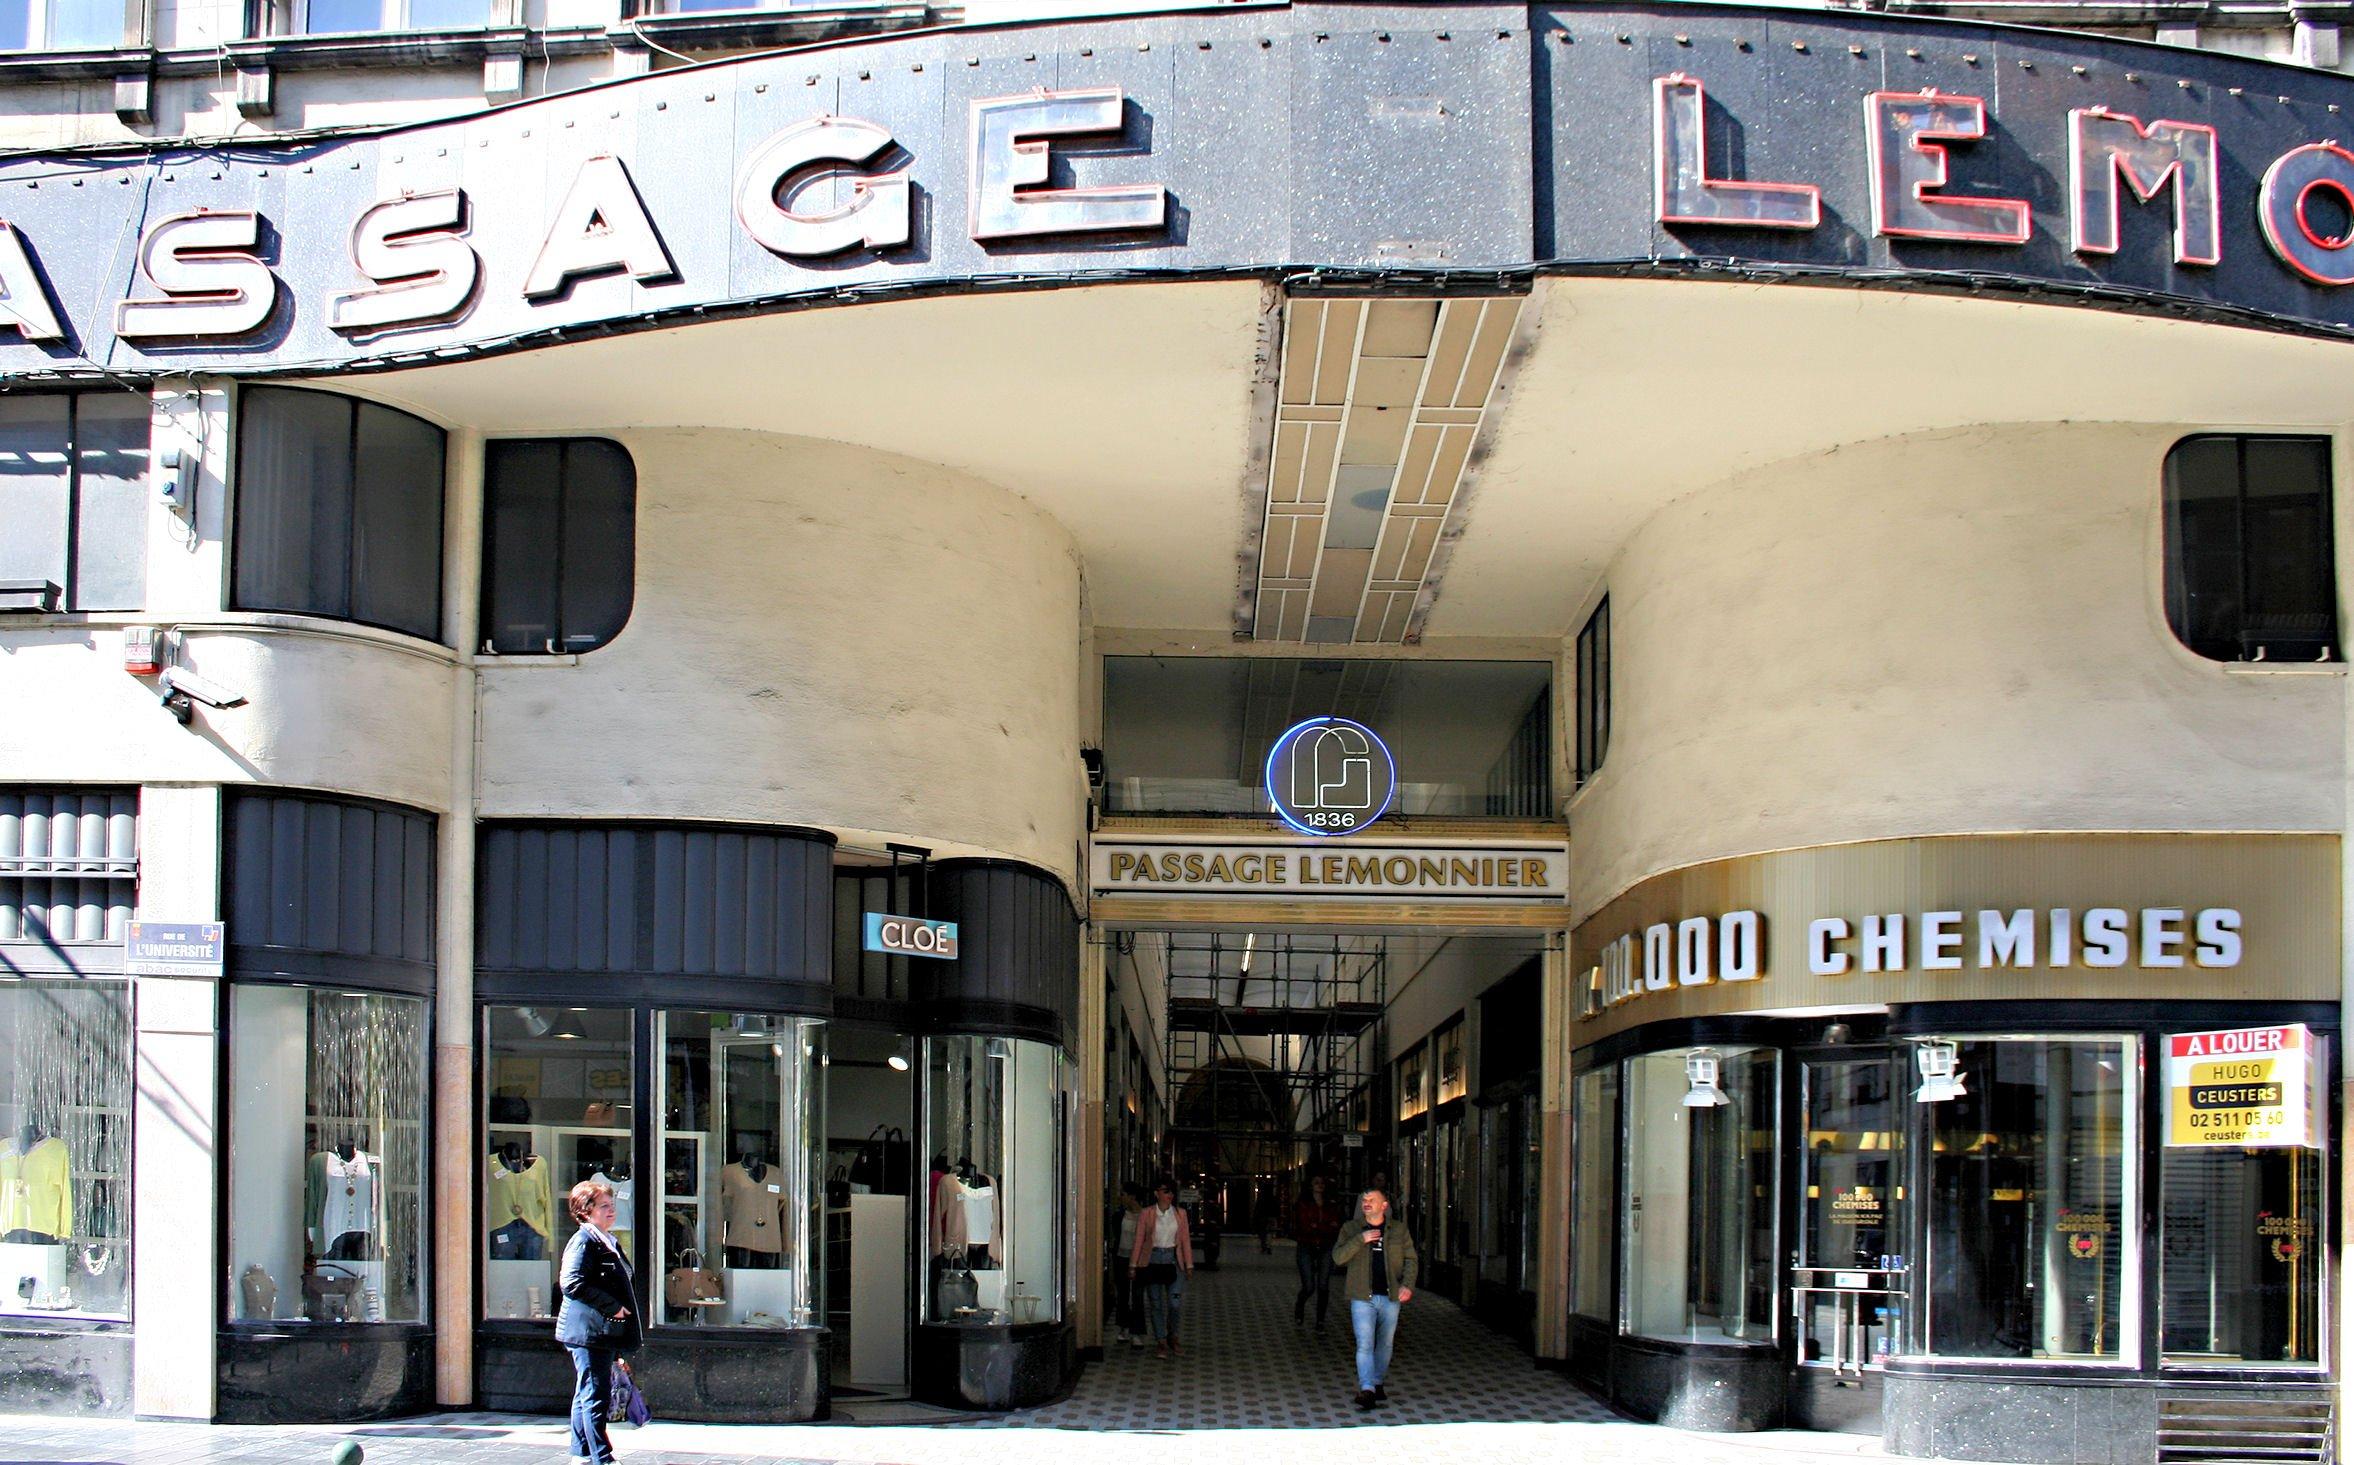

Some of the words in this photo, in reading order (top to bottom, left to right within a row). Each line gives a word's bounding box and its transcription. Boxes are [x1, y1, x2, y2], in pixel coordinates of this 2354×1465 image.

[1653, 74, 2354, 286] LEMO
[1304, 812, 1356, 827] 1836
[1110, 853, 1287, 884] PASSAGE
[1300, 856, 1549, 886] LEMONNIER
[162, 932, 176, 941] RUE
[177, 932, 187, 941] DE
[881, 922, 949, 953] CLOÉ
[1808, 907, 2243, 975] CHEMISES
[135, 943, 214, 958] L'UNIVERSITÉ
[136, 963, 172, 974] abac
[2186, 1036, 2205, 1056] A
[2209, 1030, 2282, 1054] LOUER
[2213, 1064, 2262, 1080] HUGO
[2196, 1087, 2277, 1103] CEUSTERS
[2190, 1113, 2208, 1127] 02
[2213, 1112, 2239, 1127] 511
[2245, 1112, 2261, 1126] 05
[2266, 1111, 2284, 1125] 60
[1832, 1201, 1880, 1210] CHEMISES
